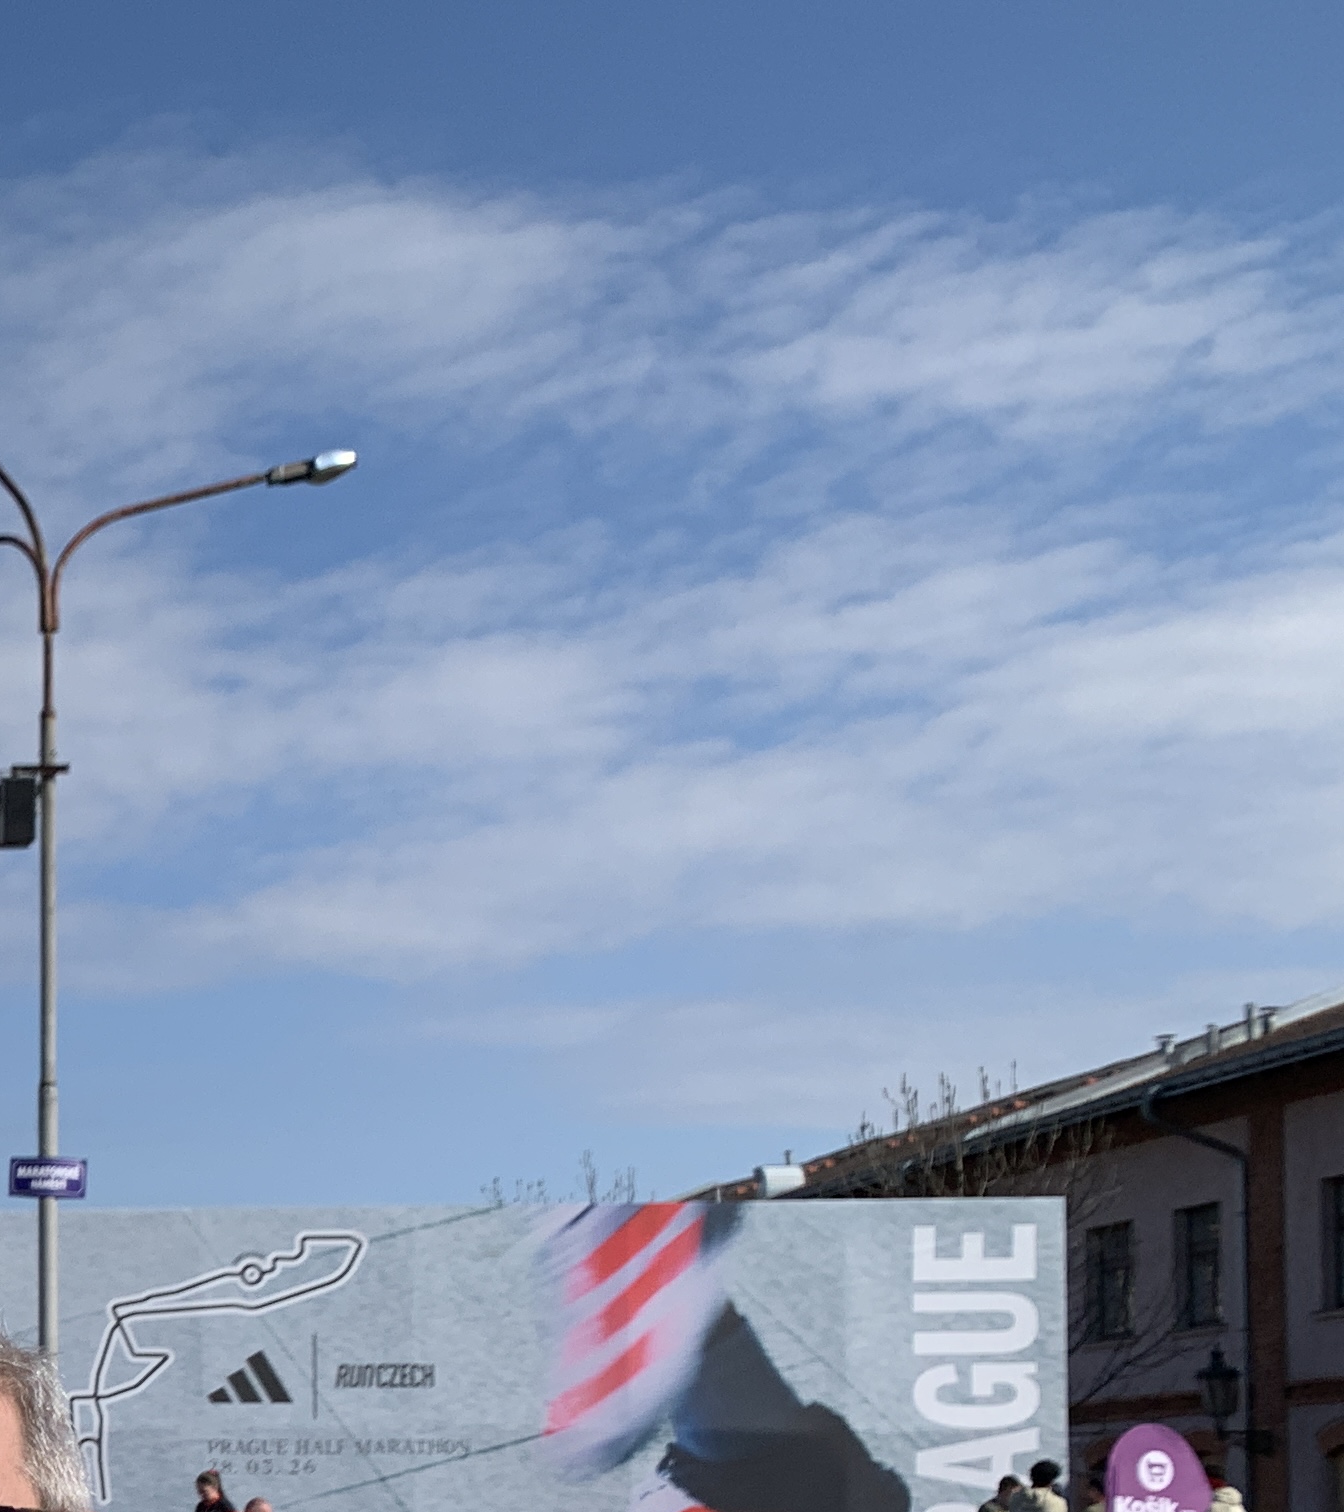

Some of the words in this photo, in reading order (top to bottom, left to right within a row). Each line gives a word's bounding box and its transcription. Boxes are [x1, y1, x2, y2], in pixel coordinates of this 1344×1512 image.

[334, 1362, 437, 1389] RUNCZECH
[205, 1437, 289, 1456] PRAGUE
[296, 1437, 346, 1456] HALF
[354, 1437, 472, 1456] MARATHON
